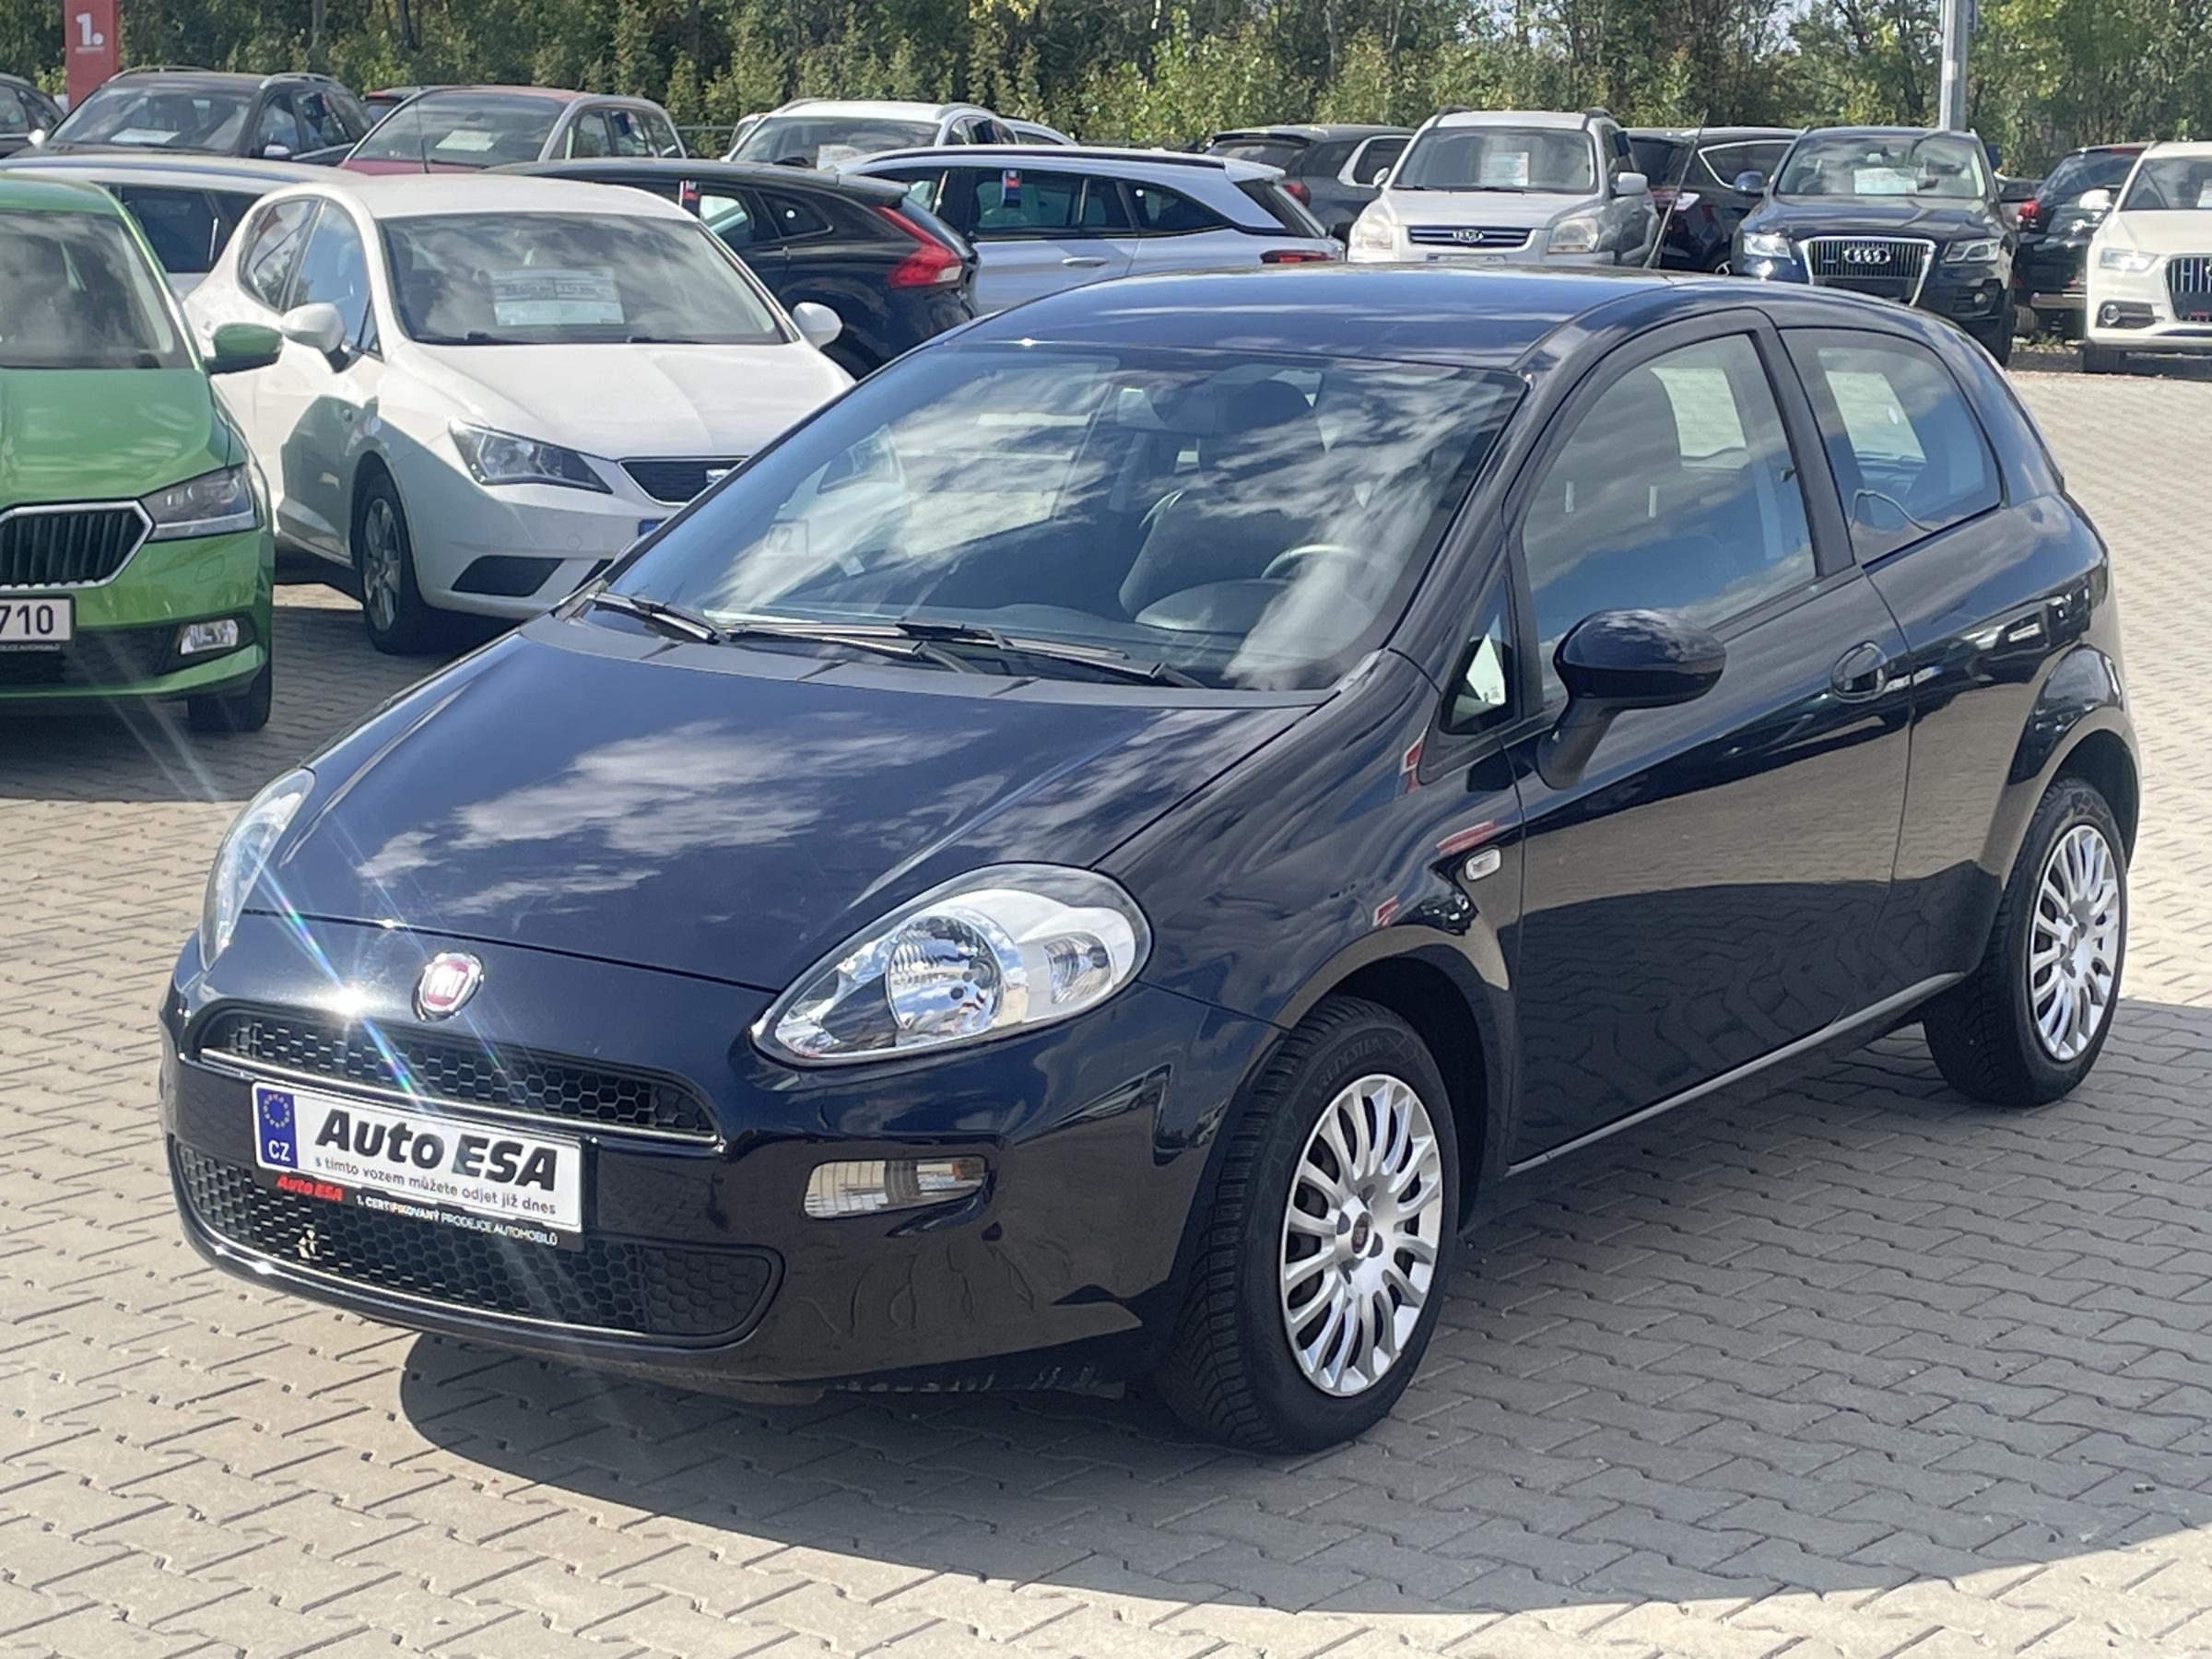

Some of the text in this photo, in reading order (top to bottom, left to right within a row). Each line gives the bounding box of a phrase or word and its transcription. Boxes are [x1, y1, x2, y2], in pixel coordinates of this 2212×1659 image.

[76, 13, 103, 45] 1.
[0, 605, 53, 635] 710
[268, 1139, 291, 1162] CZ
[315, 1108, 558, 1192] Auto ESA
[315, 1157, 323, 1168] s
[363, 1167, 406, 1186] vozem
[408, 1175, 458, 1196] můžete
[462, 1185, 498, 1204] odjet
[522, 1196, 556, 1214] dnes
[356, 1194, 364, 1206] 1.
